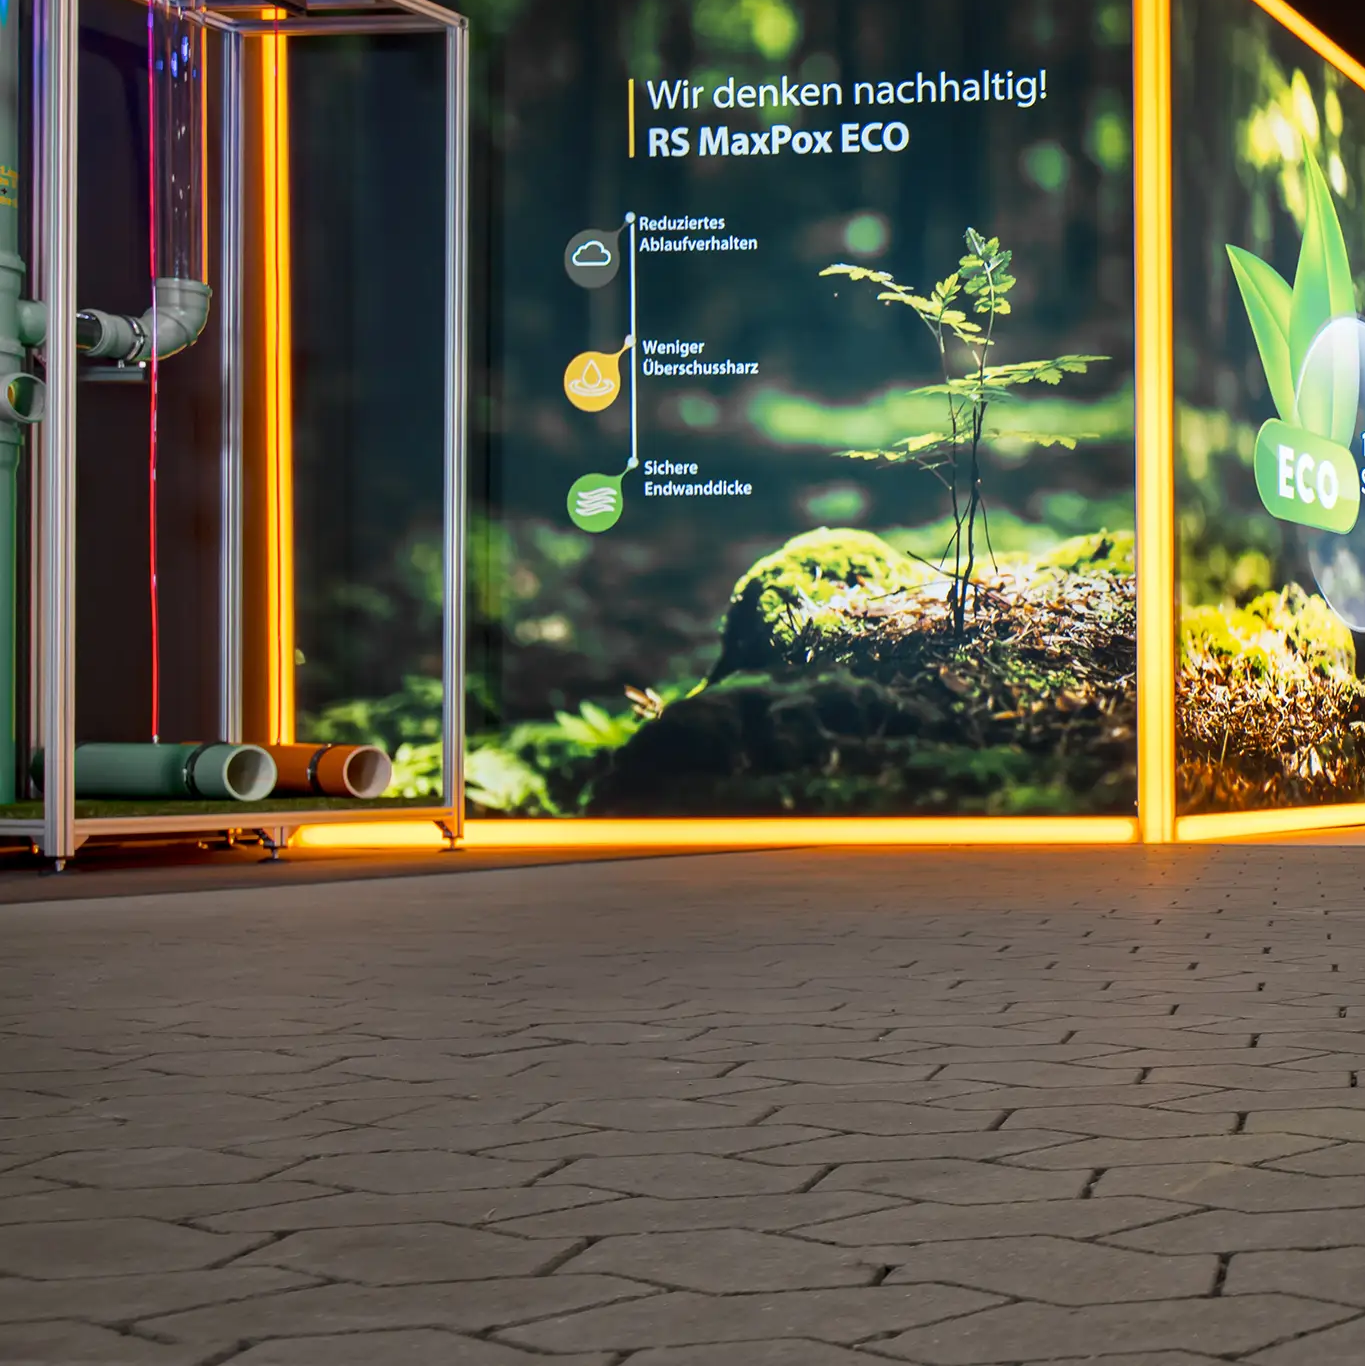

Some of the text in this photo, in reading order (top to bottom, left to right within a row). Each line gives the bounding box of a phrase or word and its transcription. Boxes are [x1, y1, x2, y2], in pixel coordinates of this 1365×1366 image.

[646, 69, 1047, 110] Wir denken nachhaltig!
[649, 122, 910, 157] RS MaxPox ECO
[639, 215, 726, 231] Reduziertes
[639, 235, 758, 252] Ablaufverhalten
[642, 339, 705, 358] Weniger
[642, 357, 760, 377] Überschussharz
[644, 459, 699, 476] Sichere
[1278, 444, 1340, 510] ECO
[644, 479, 753, 497] Endwanddicke
